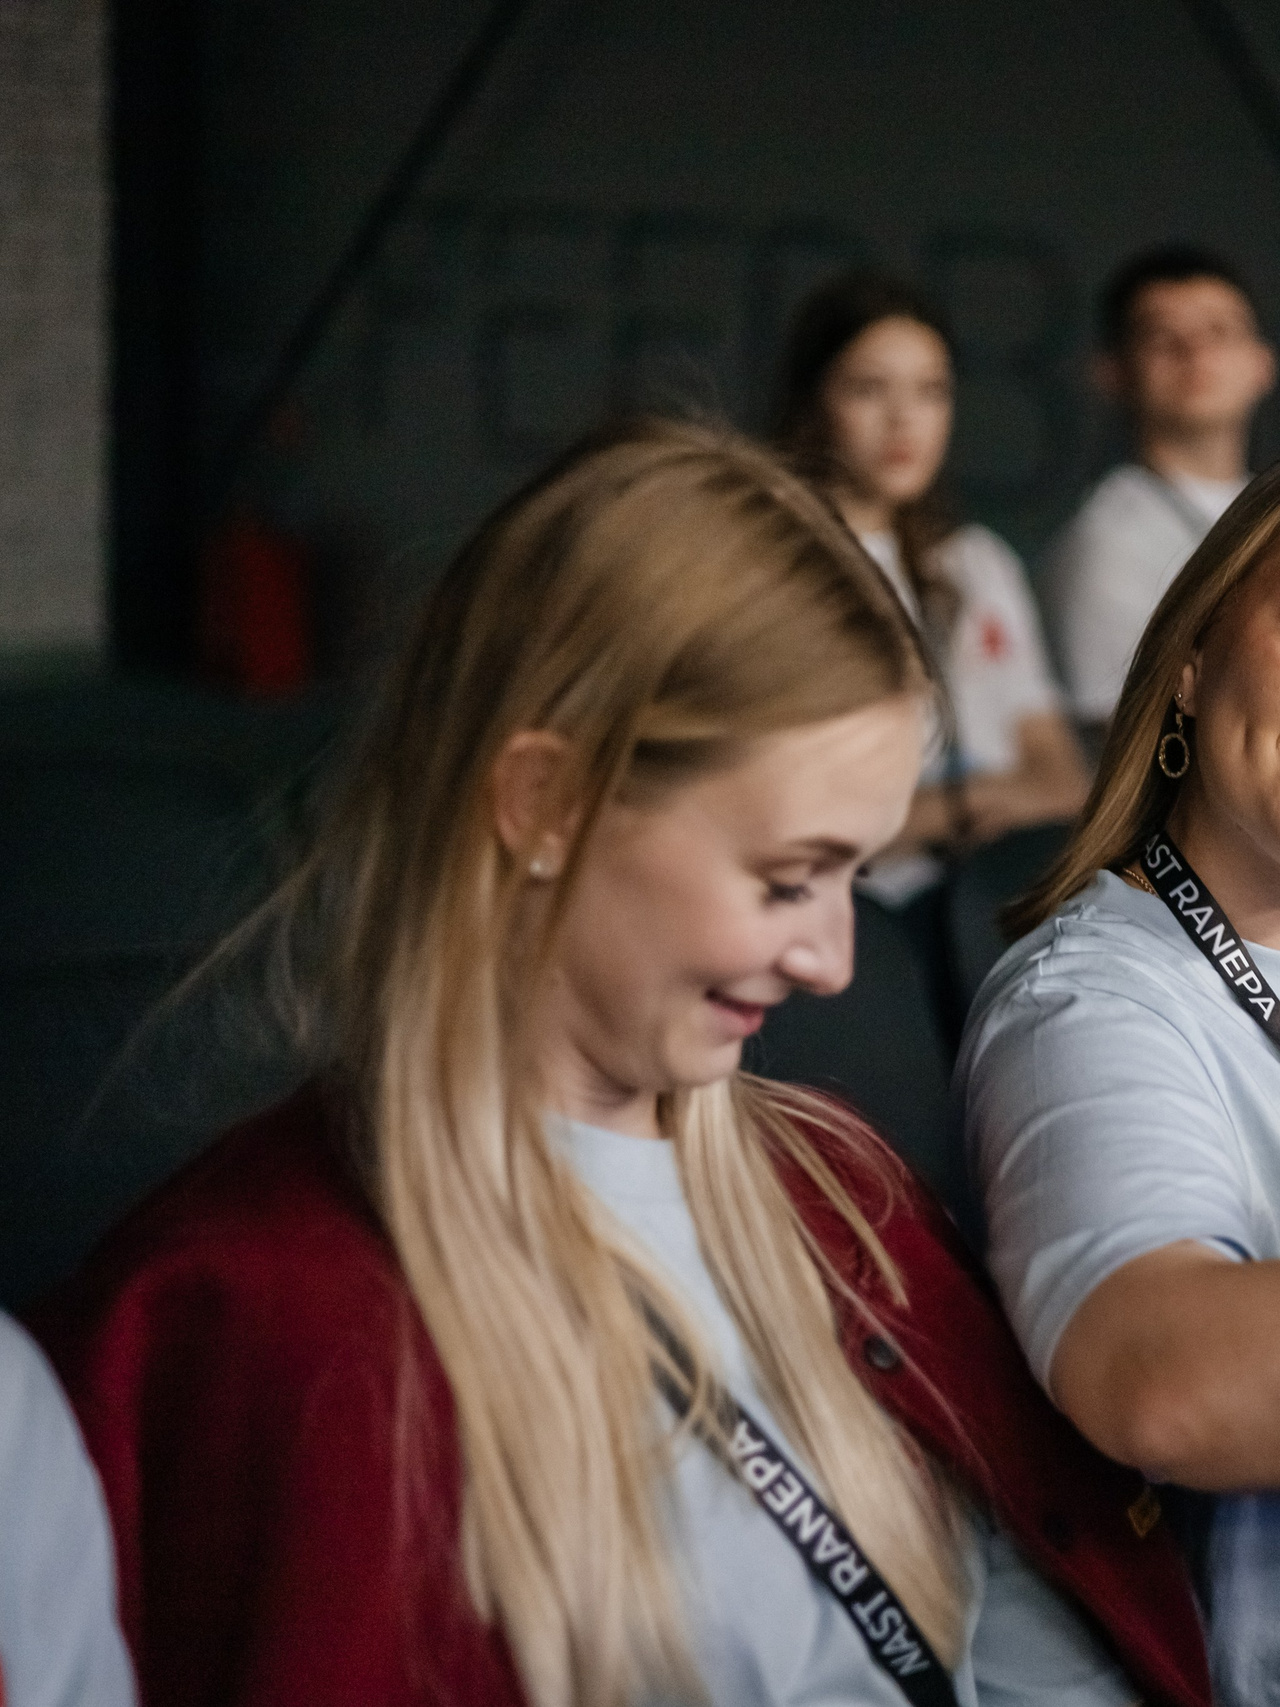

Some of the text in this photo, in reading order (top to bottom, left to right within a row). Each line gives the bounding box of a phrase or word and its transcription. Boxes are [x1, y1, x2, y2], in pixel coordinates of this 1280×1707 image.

[1145, 832, 1277, 1021] AST RANEPA
[729, 1420, 931, 1678] NAST RANEPA
